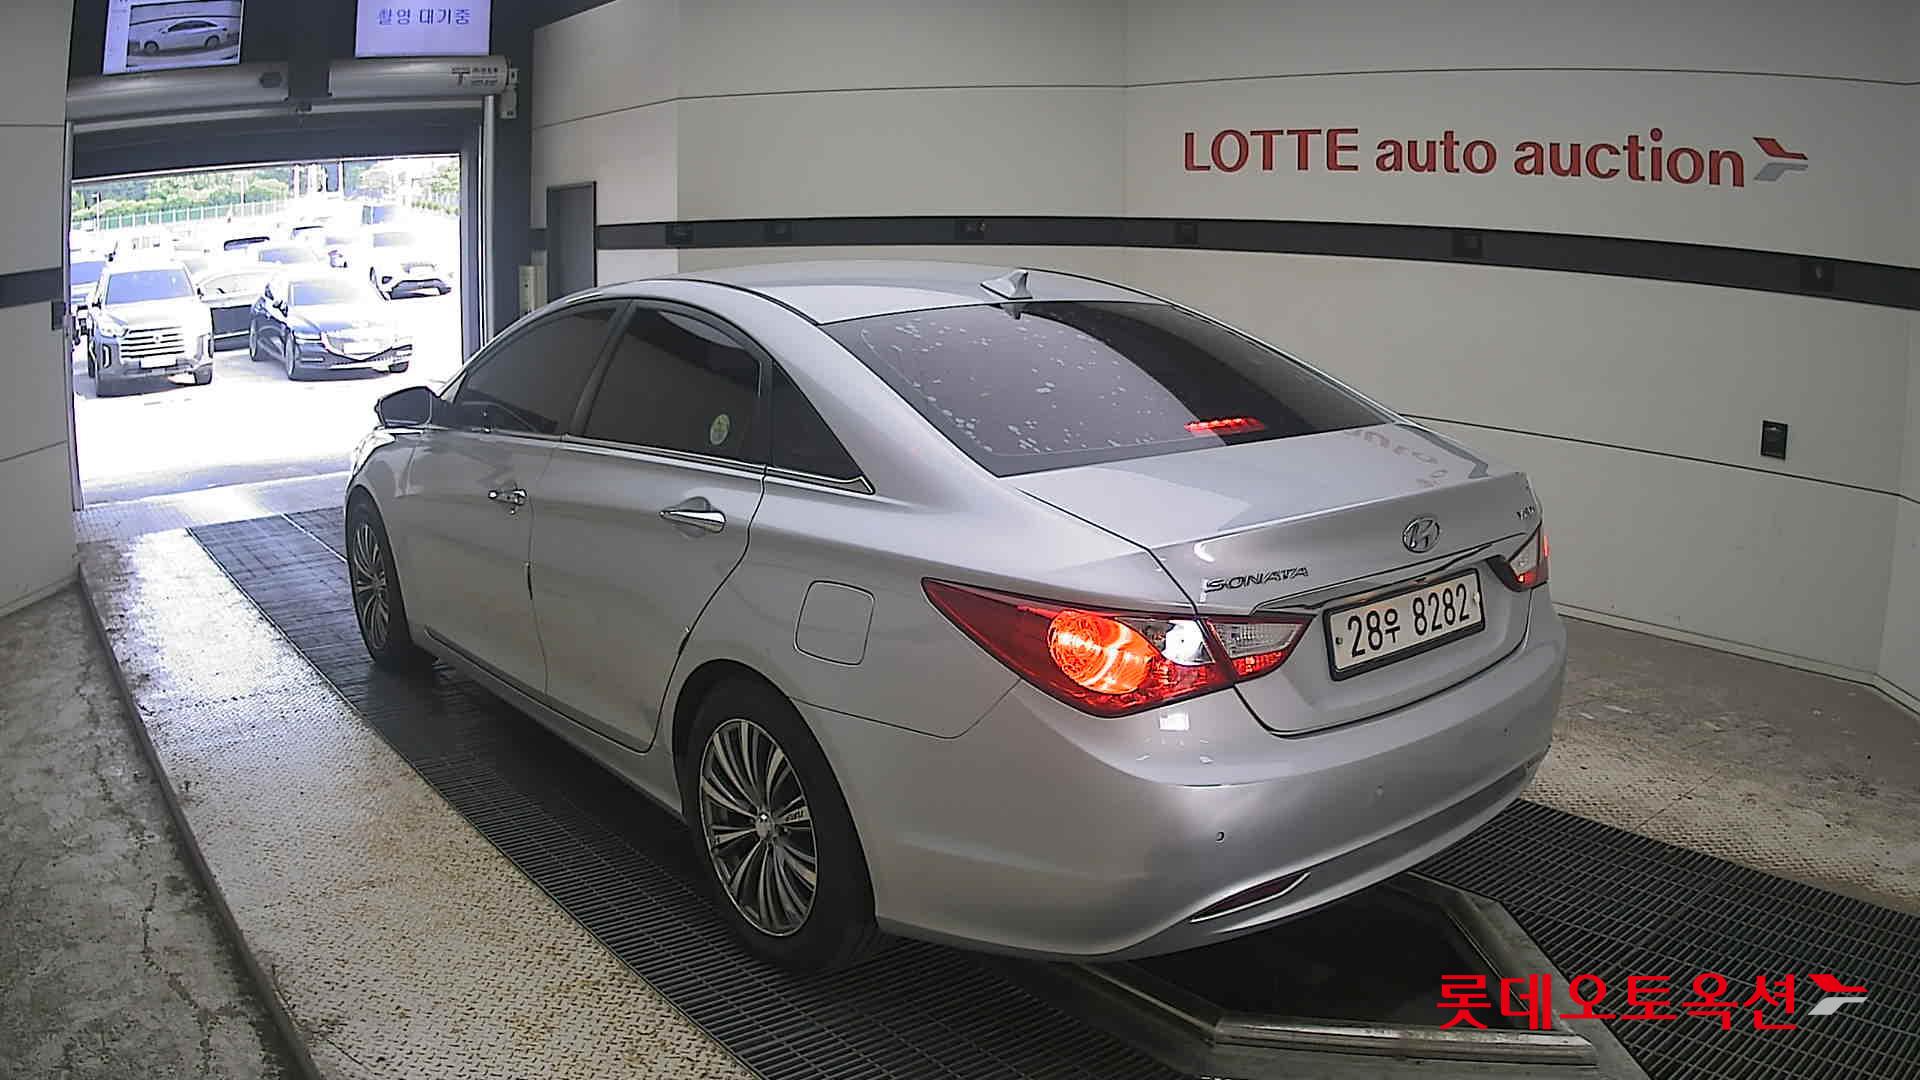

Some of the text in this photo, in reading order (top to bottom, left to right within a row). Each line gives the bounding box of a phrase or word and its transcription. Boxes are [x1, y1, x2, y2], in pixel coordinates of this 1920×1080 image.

[419, 8, 471, 25] 대기중
[1184, 127, 1745, 188] LOTTE auto auction
[1204, 567, 1309, 593] SONATA
[1347, 583, 1470, 658] 28우 8282
